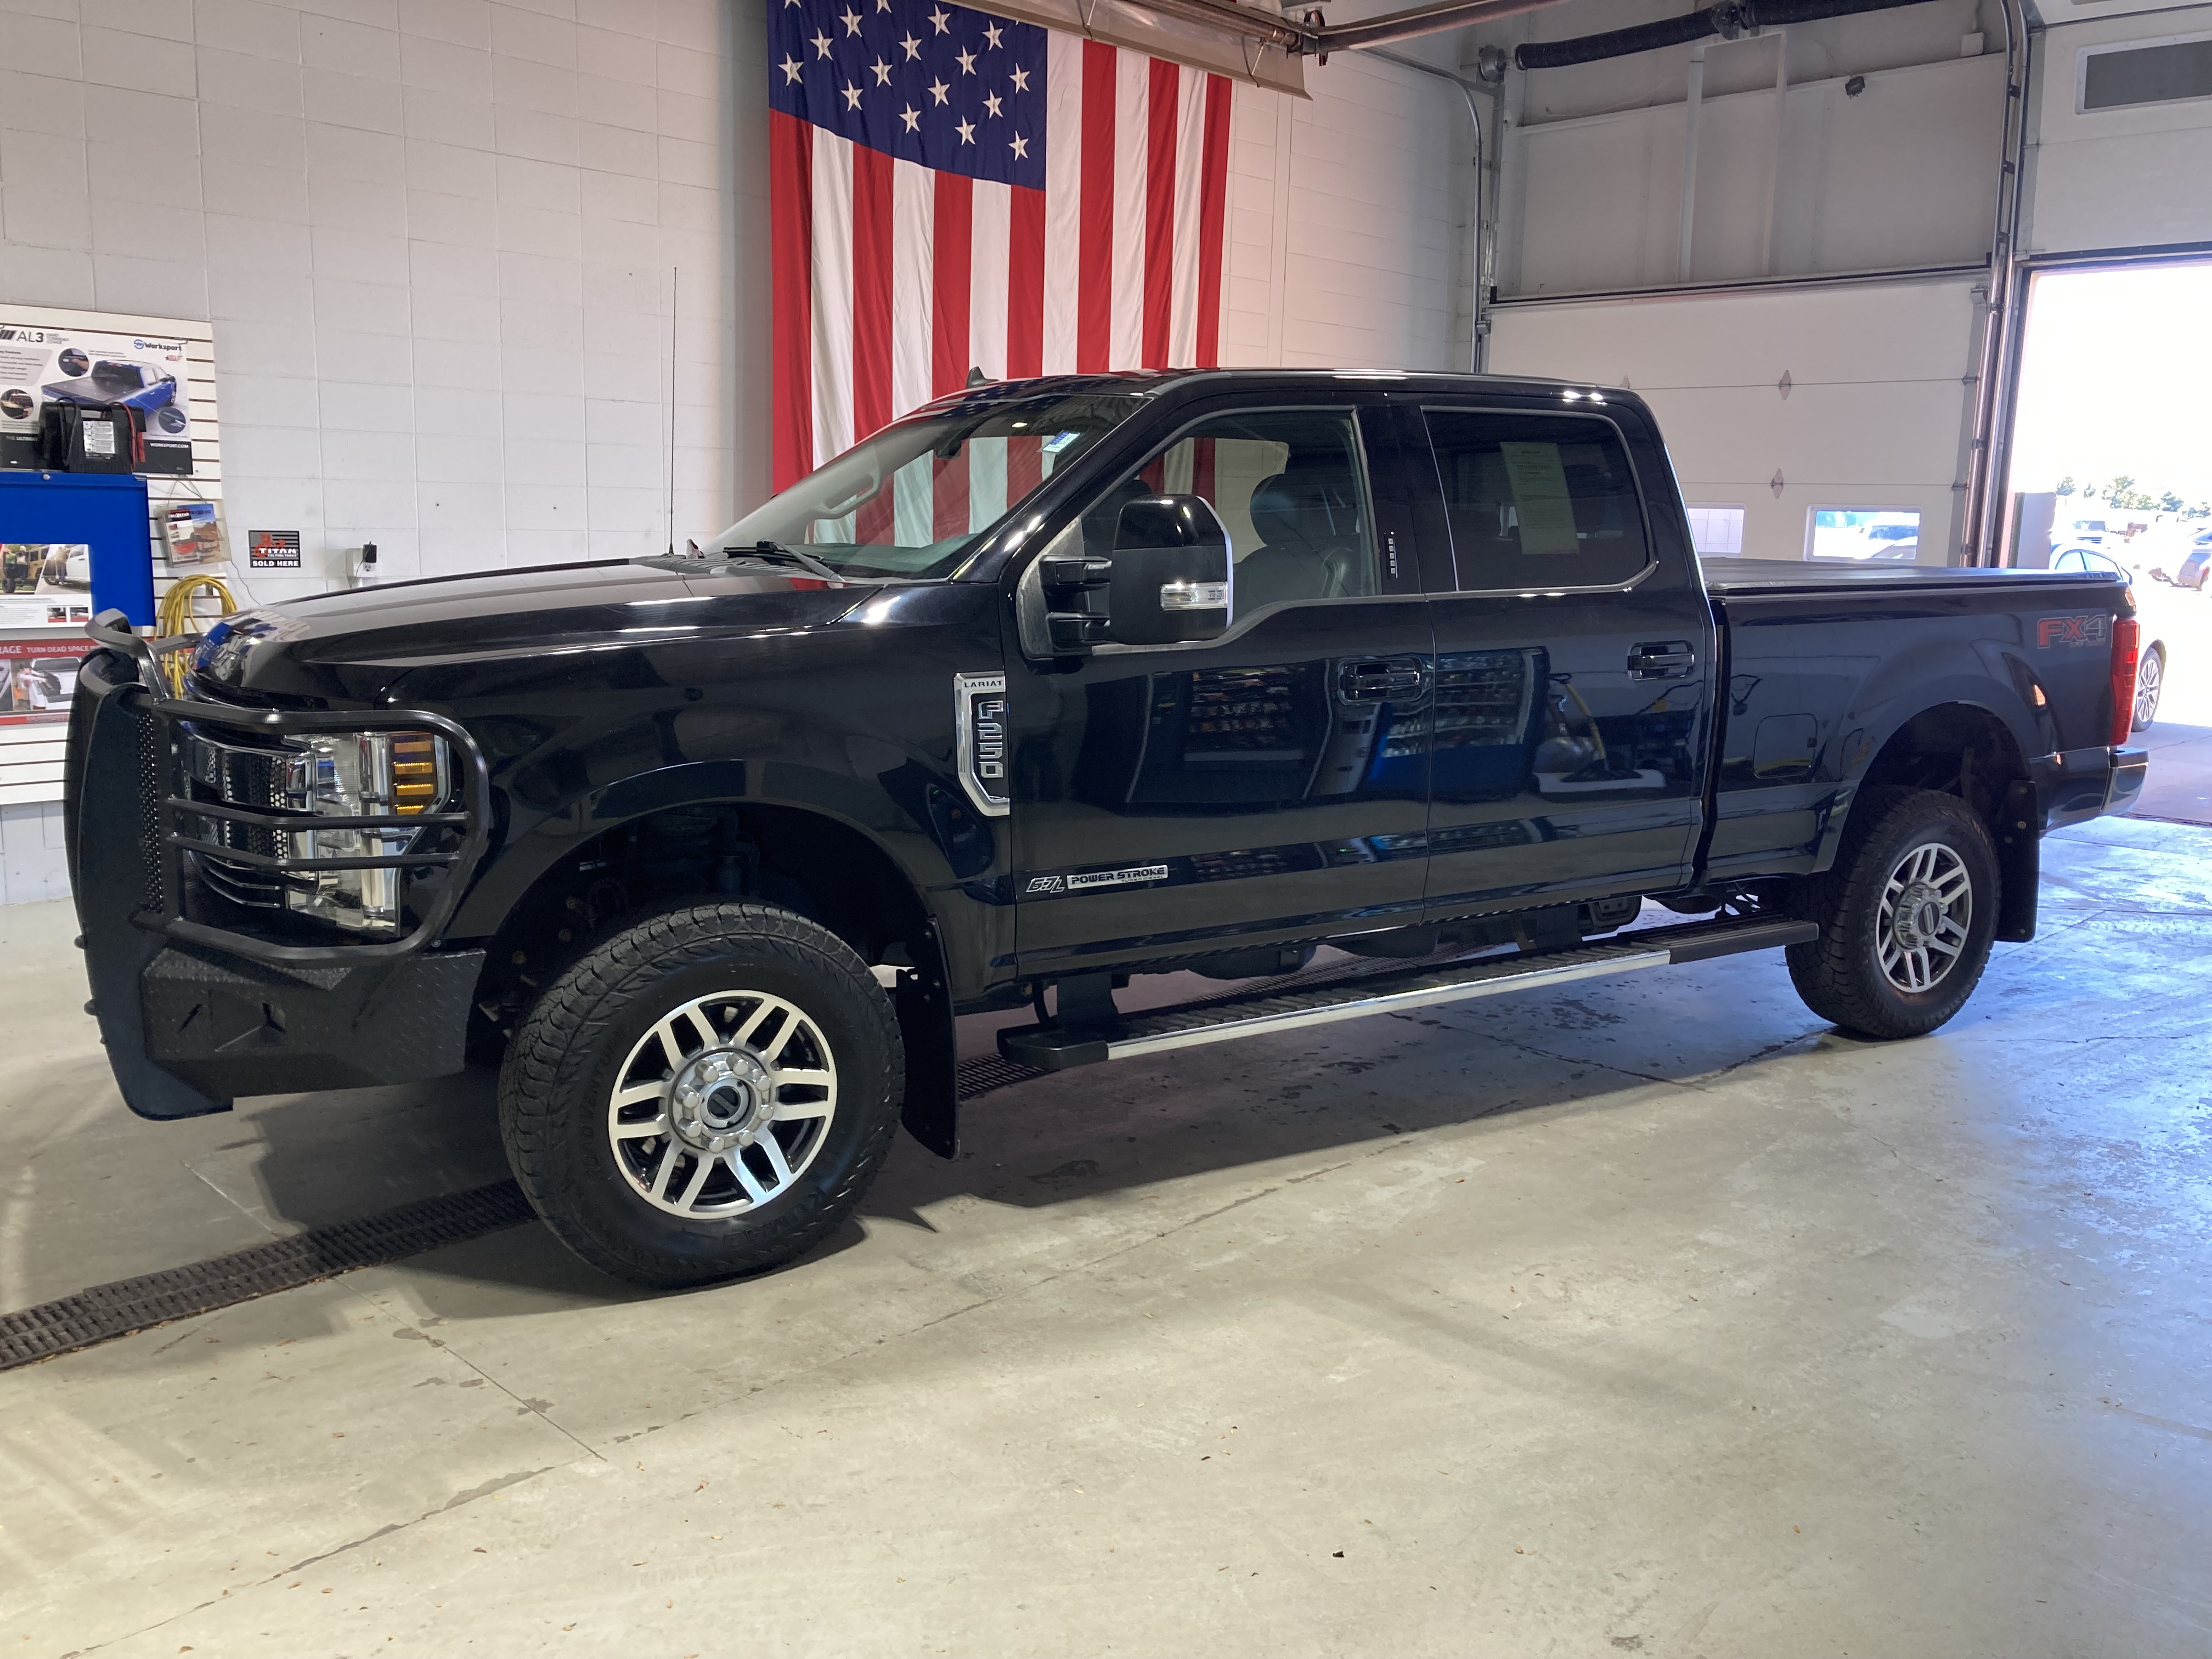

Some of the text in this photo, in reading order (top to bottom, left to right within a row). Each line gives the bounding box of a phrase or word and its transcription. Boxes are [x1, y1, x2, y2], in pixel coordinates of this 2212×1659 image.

[16, 331, 44, 343] AL3
[144, 342, 182, 351] Worksport
[2037, 614, 2107, 649] FX4
[977, 700, 1004, 779] F250
[1026, 867, 1165, 894] 6.7L POWER STROKE
[723, 1186, 827, 1252] KUMHO
